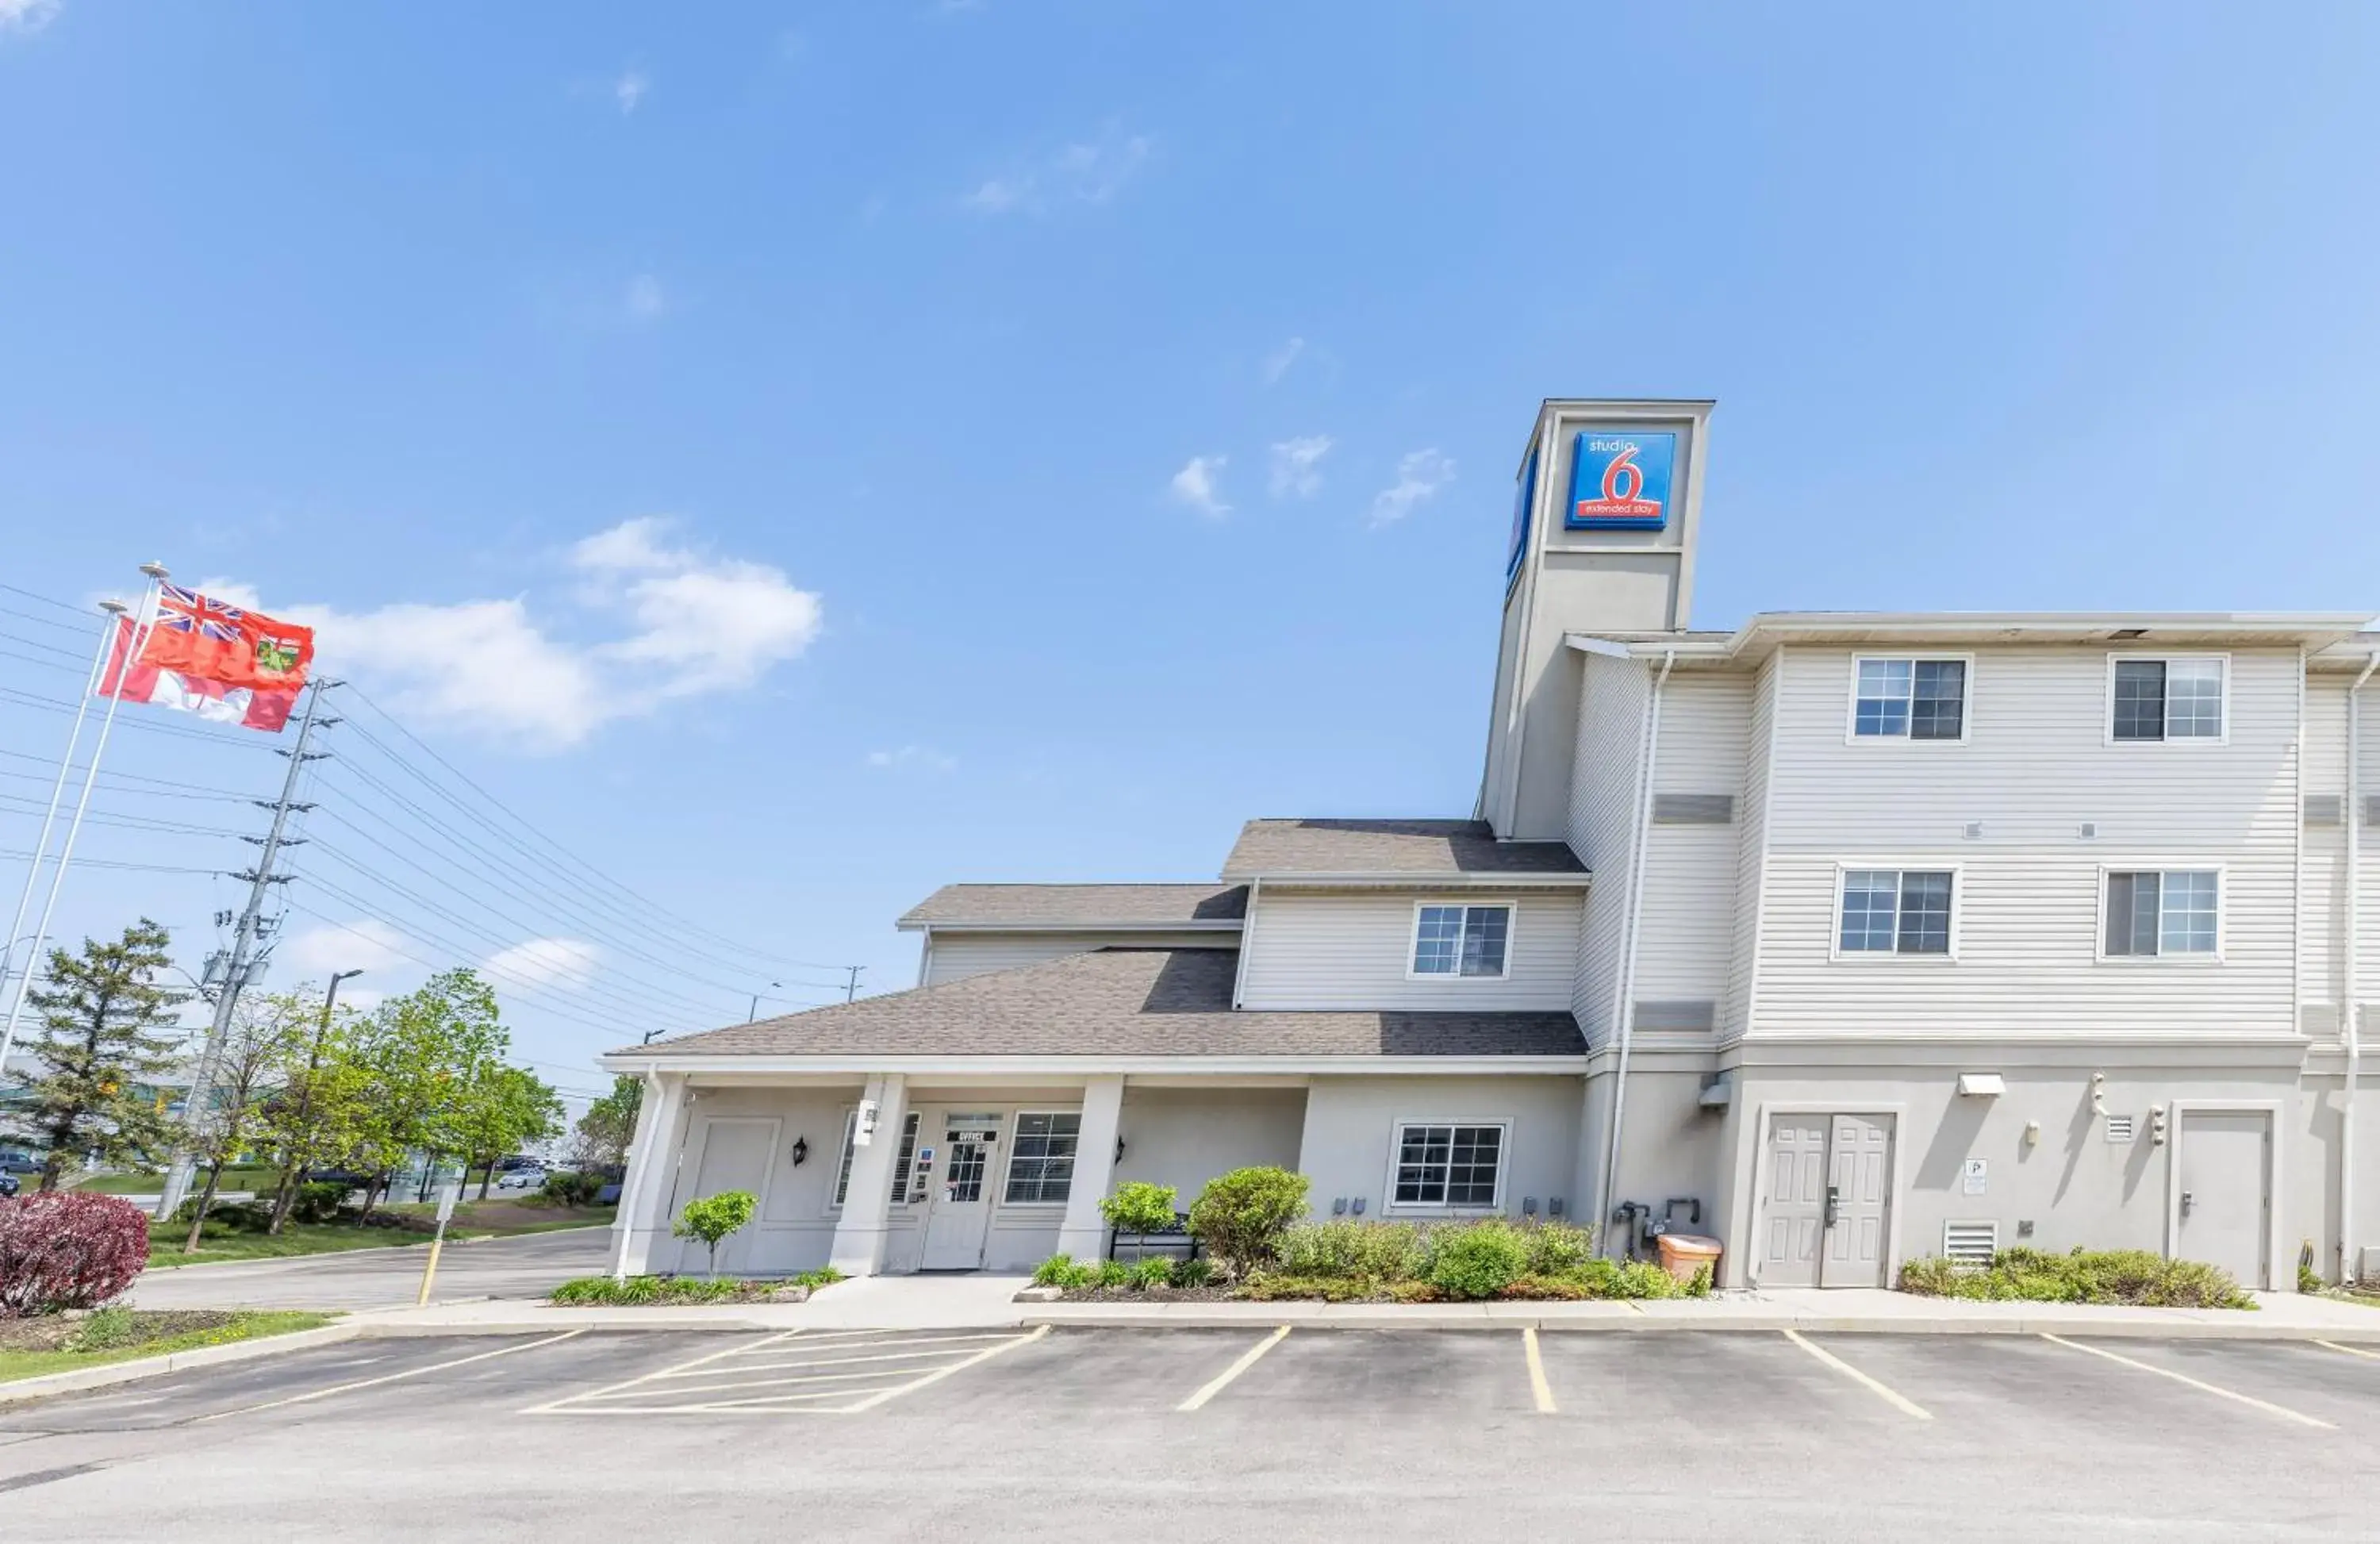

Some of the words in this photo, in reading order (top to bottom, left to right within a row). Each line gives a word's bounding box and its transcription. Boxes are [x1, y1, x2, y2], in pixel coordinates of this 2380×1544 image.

[1589, 439, 1635, 451] studio
[1601, 447, 1643, 505] 6
[1585, 504, 1630, 514] extended
[1633, 505, 1653, 514] stay
